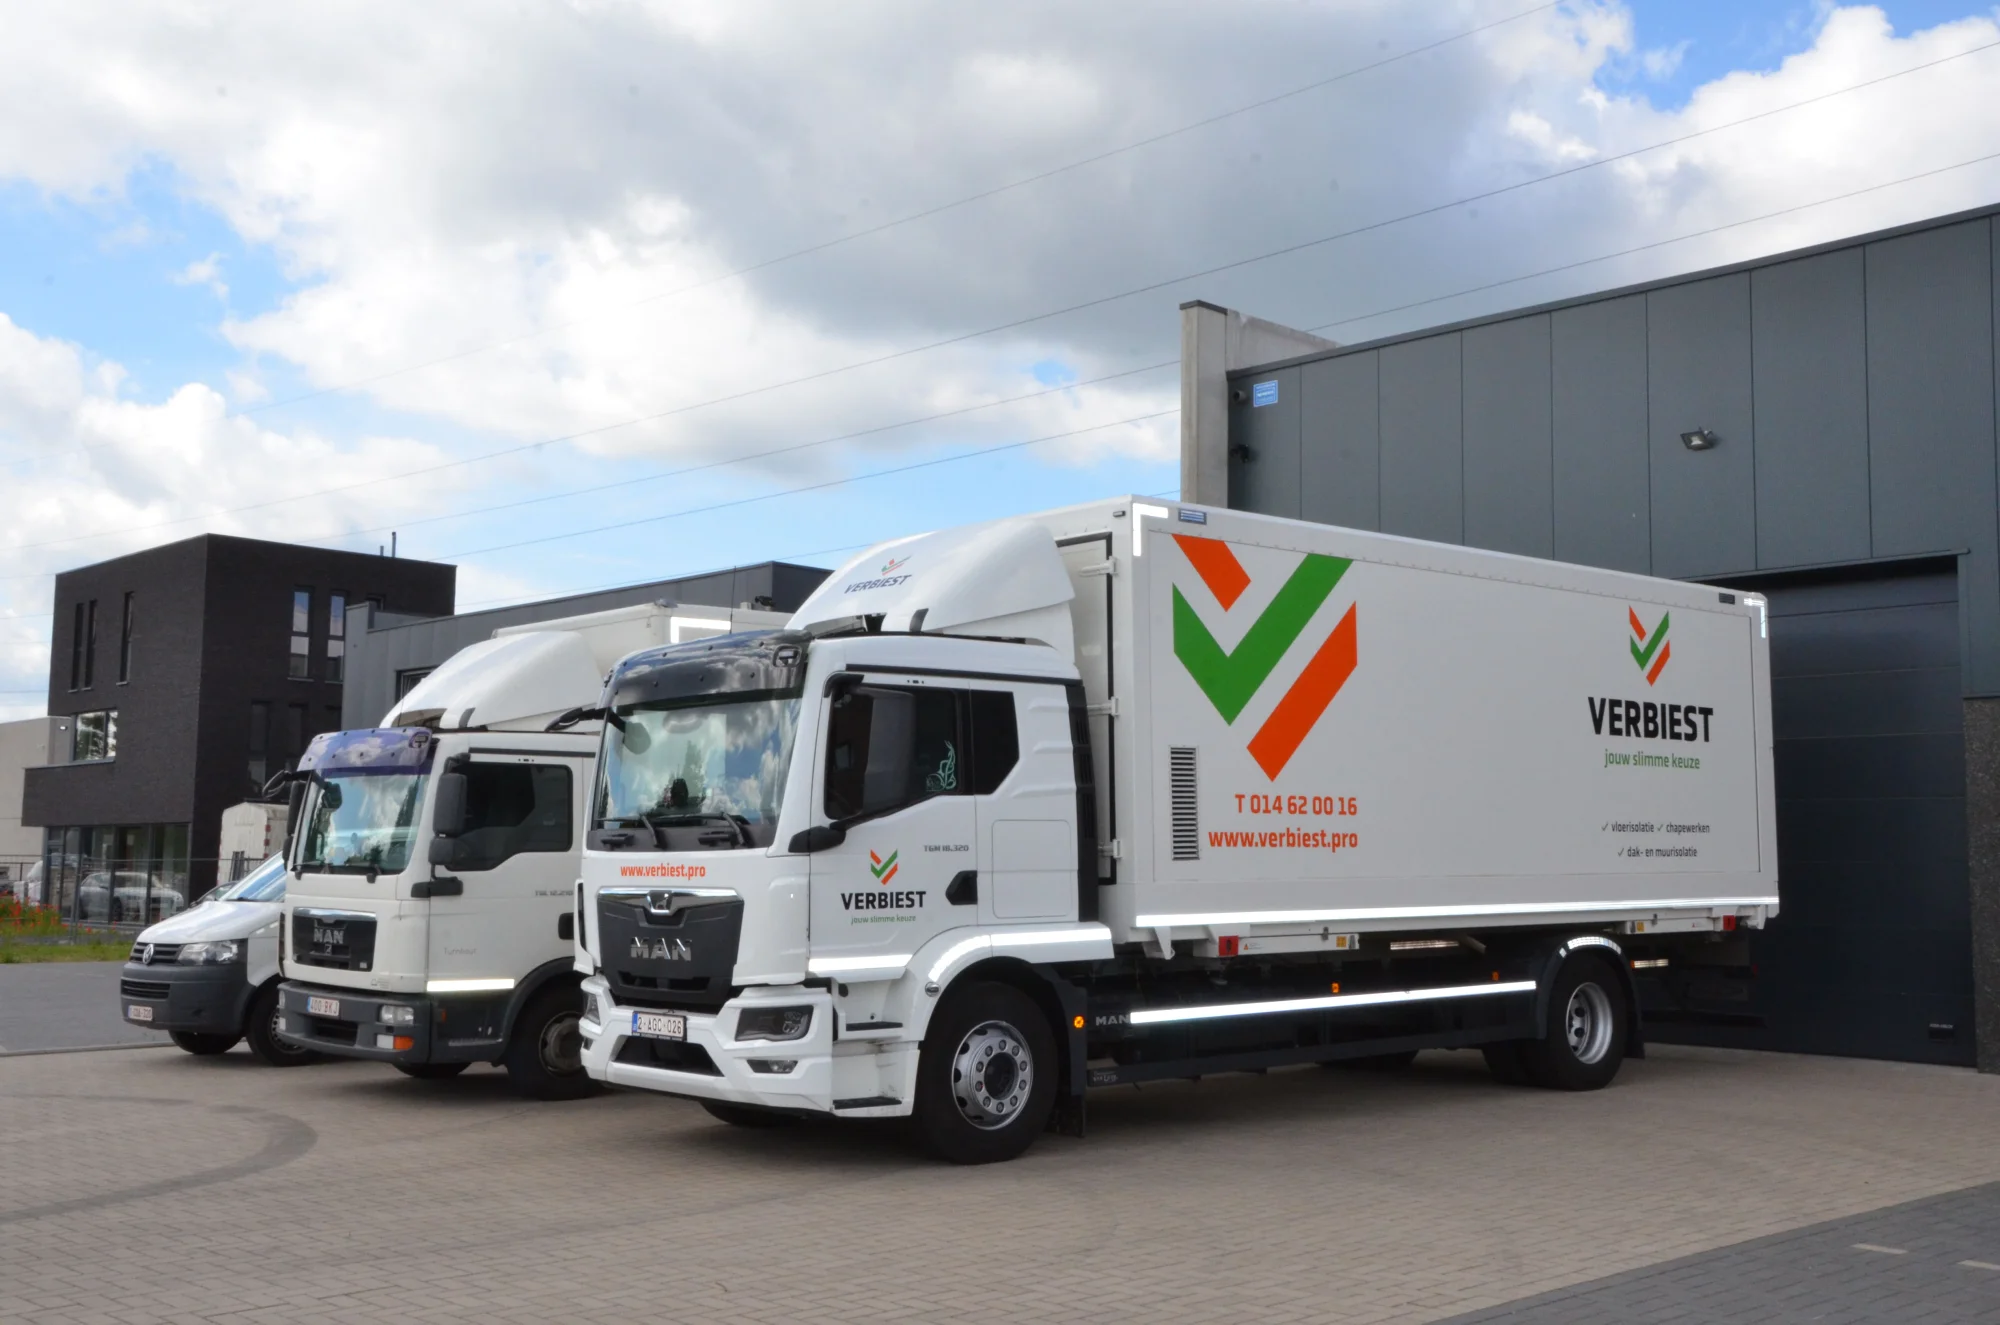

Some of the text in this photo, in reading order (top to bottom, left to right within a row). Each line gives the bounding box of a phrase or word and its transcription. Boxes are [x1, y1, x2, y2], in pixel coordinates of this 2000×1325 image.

[844, 575, 912, 594] VERBIEST
[1588, 697, 1714, 742] VERBIEST
[1604, 748, 1701, 770] jouw slimme keuze
[1235, 794, 1358, 816] T 014 62 00 16
[1611, 820, 1710, 835] vloerisolatie chapewerken
[1208, 827, 1359, 853] www.verbiest.pro
[1627, 846, 1697, 858] dak- en muurisolatie
[620, 863, 706, 881] www.verbiest.pro
[840, 891, 927, 910] VERBIEST
[851, 913, 917, 925] jouw slimme keuze
[313, 928, 346, 945] MAN
[630, 936, 693, 961] MAN
[1095, 1014, 1131, 1026] MAN
